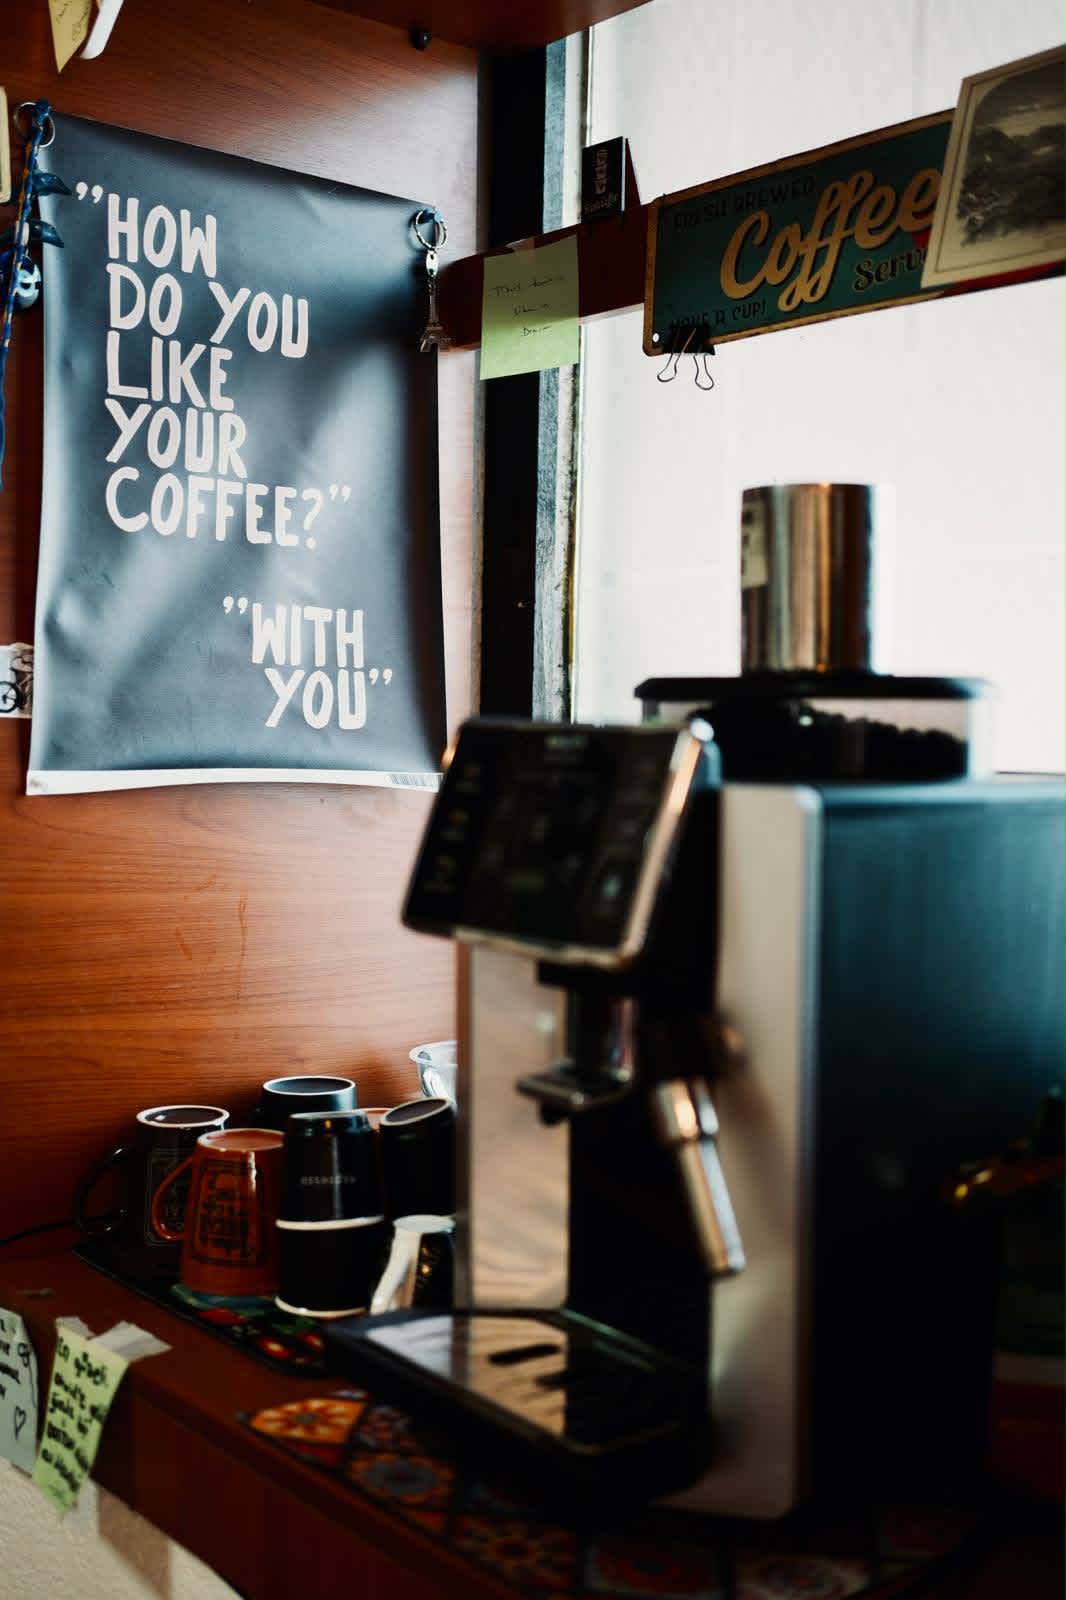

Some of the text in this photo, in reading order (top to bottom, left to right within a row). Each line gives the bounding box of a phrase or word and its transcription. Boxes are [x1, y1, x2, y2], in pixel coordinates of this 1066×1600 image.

[719, 168, 942, 312] Coffee
[852, 249, 929, 293] Serv
[106, 263, 309, 358] DO YOU
[732, 299, 768, 321] CUP!
[106, 331, 235, 412] LIKE
[105, 398, 248, 479] YOUR
